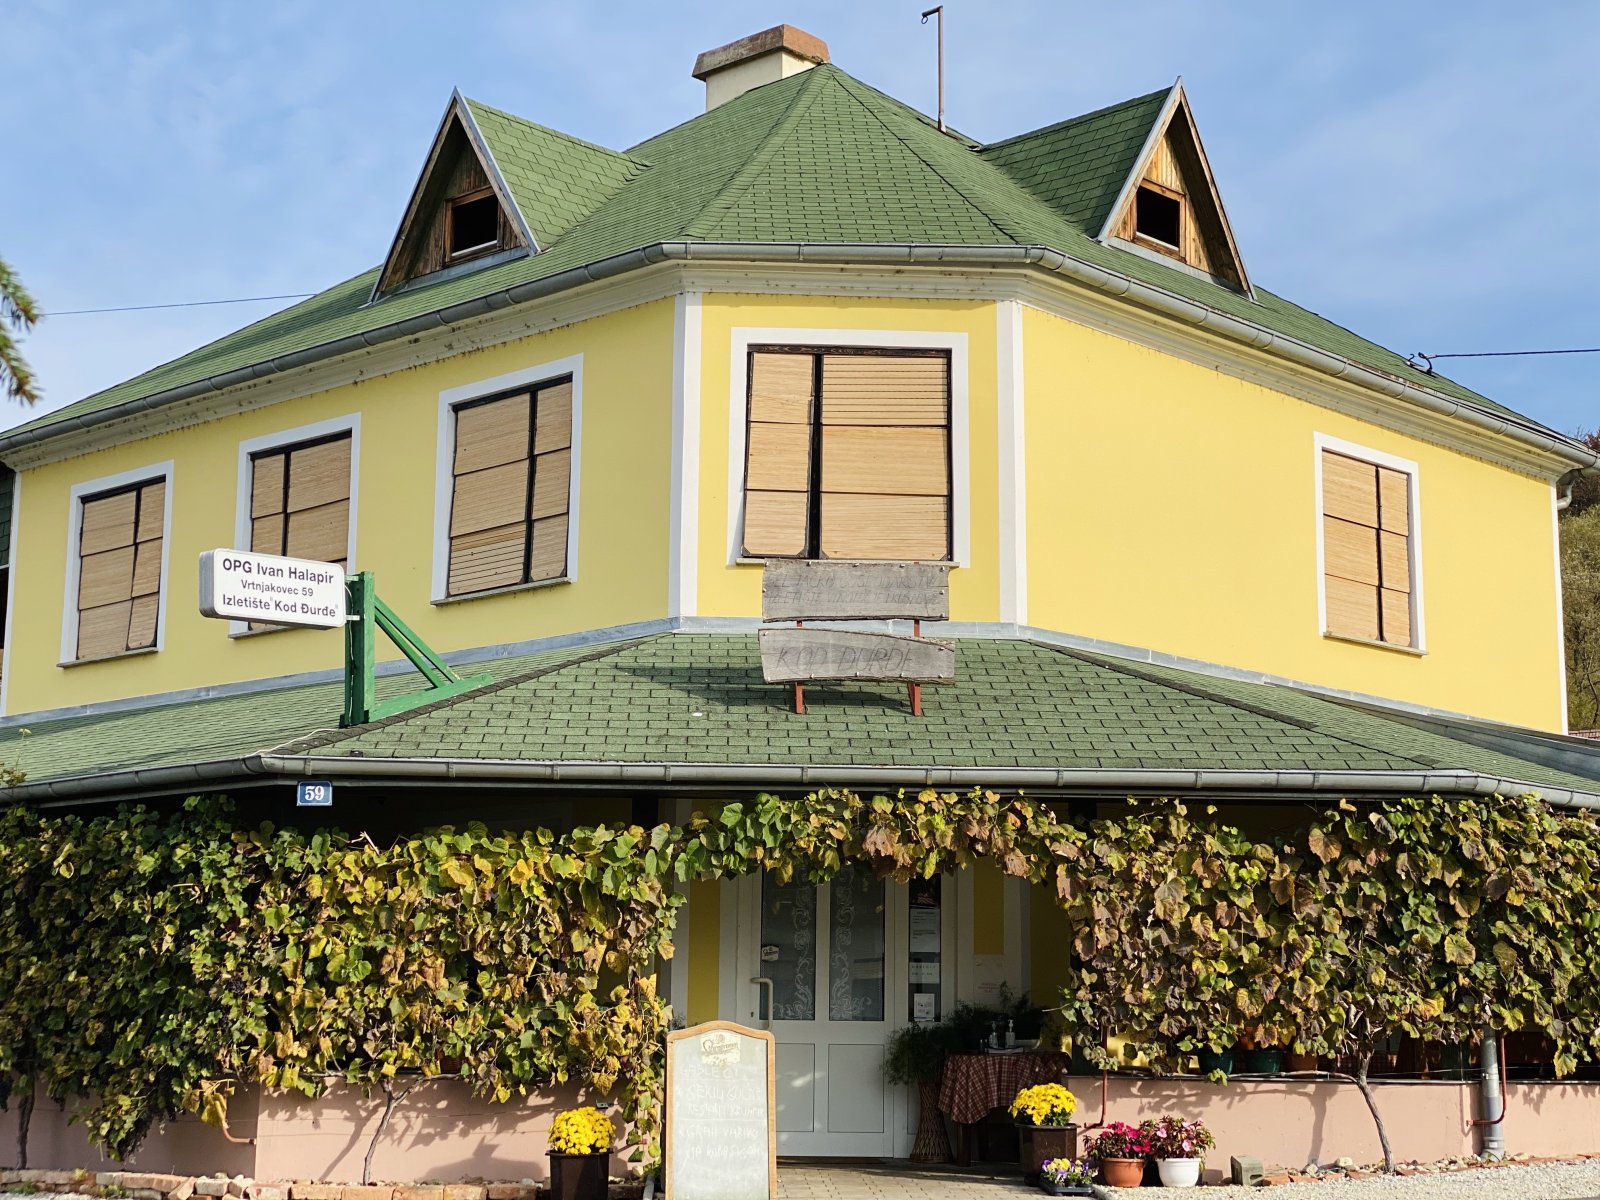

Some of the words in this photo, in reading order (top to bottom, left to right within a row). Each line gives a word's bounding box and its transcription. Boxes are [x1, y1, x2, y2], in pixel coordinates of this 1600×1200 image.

[222, 558, 252, 574] OPG
[257, 563, 284, 578] Ivan
[288, 566, 335, 584] Halapir
[241, 579, 299, 595] Vrtnjakovec
[301, 587, 314, 597] 59
[222, 594, 271, 610] Izletište
[776, 646, 828, 674] KOD
[304, 785, 325, 801] 59
